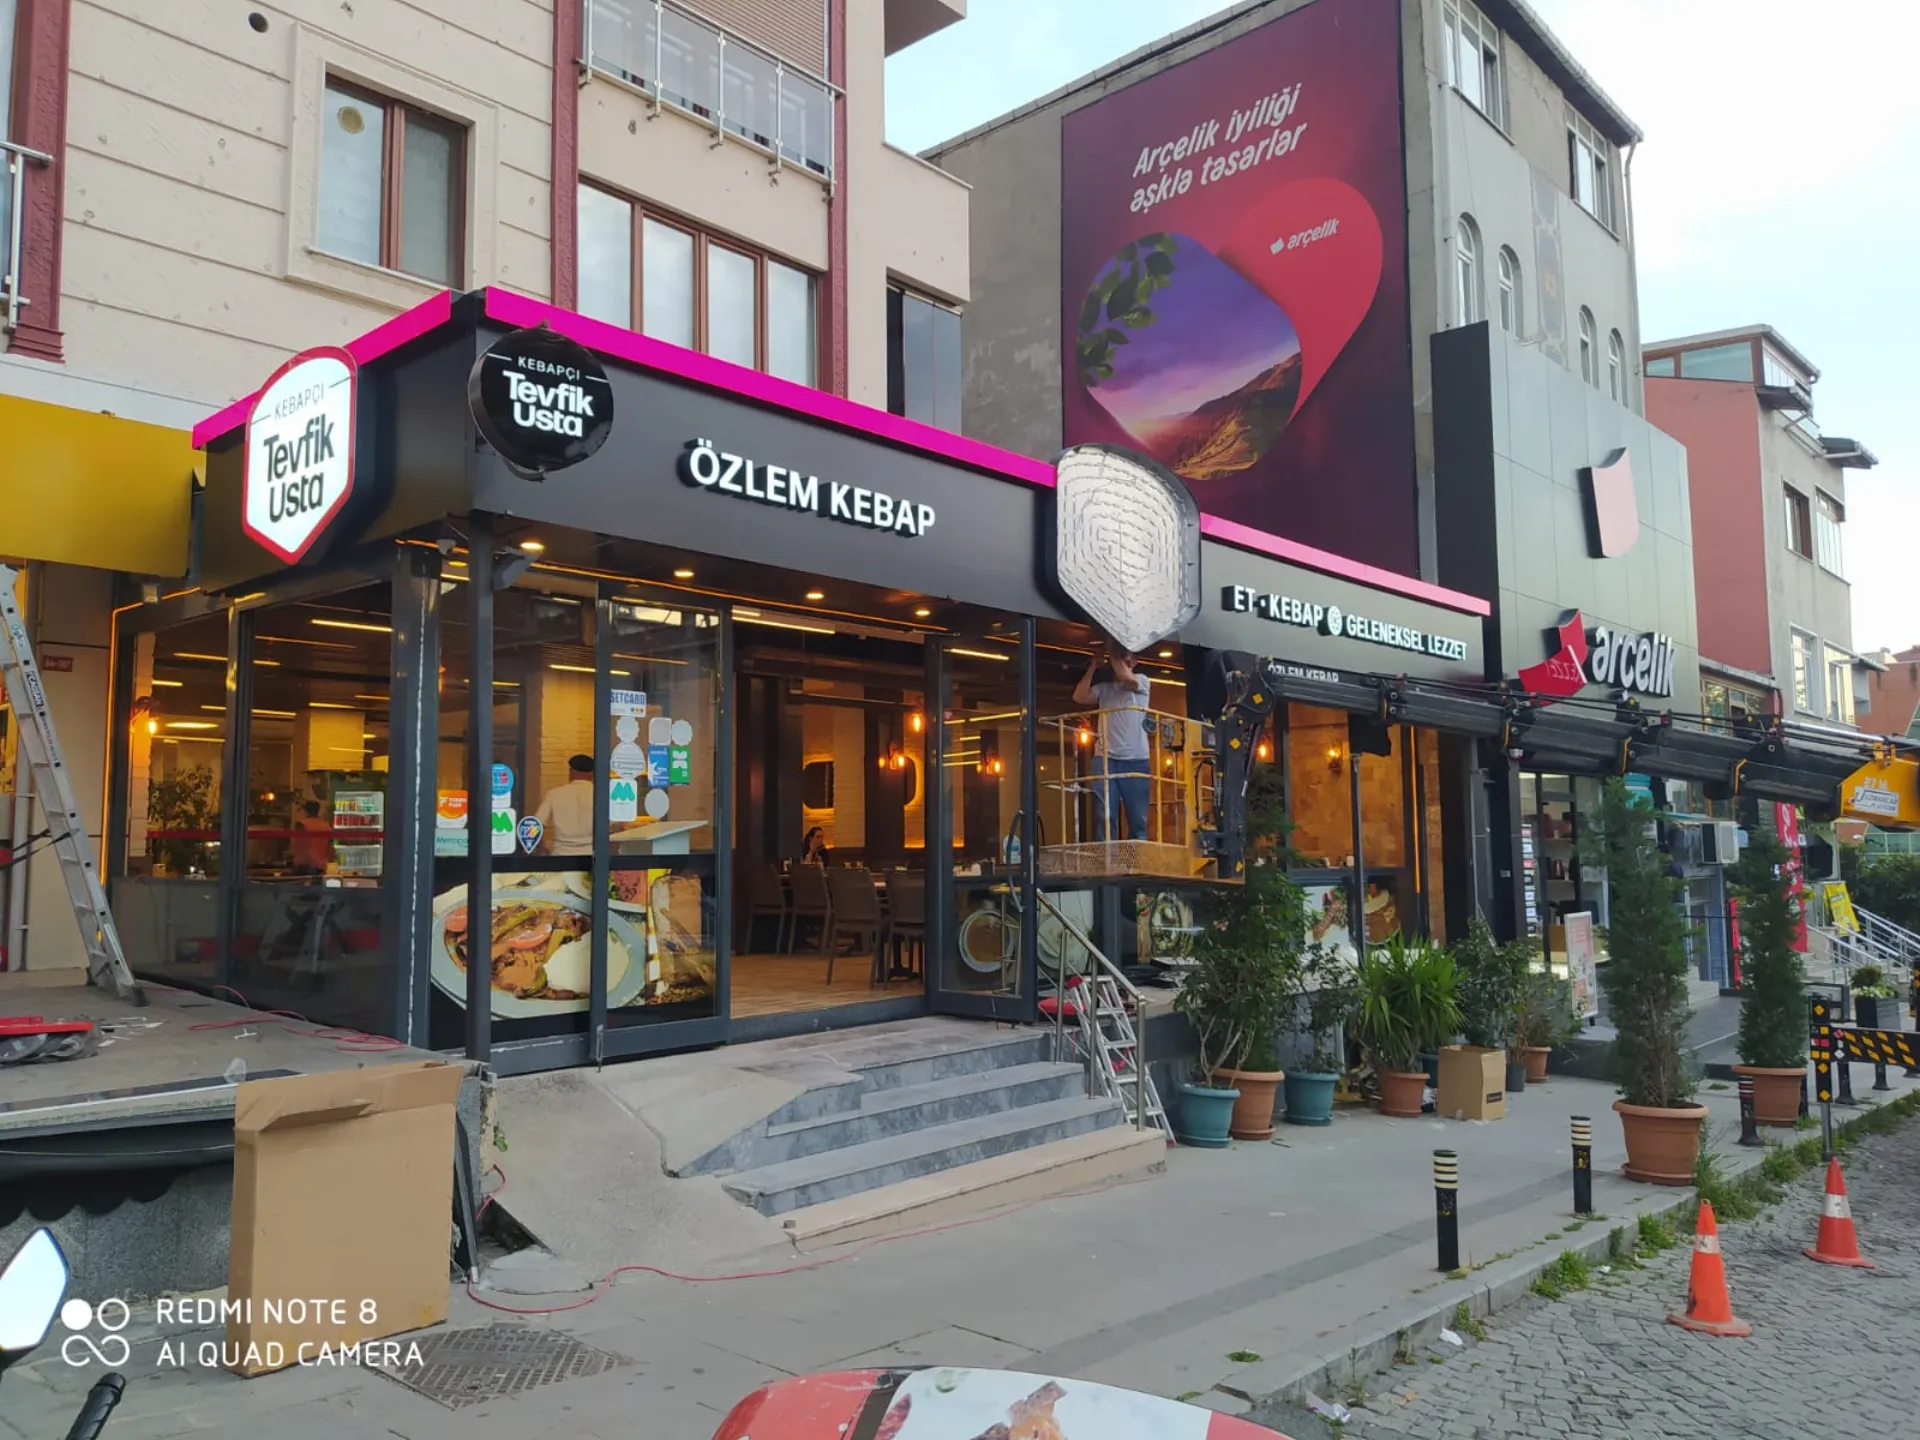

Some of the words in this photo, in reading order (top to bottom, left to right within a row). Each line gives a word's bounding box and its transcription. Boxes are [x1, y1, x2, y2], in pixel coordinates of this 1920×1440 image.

[1132, 118, 1220, 178] Arçelik
[1224, 82, 1302, 143] iyiliği
[1130, 167, 1194, 214] aşkla
[1200, 122, 1308, 186] tasarlar
[1286, 217, 1340, 250] arçelik
[502, 369, 595, 417] Tevfik
[517, 356, 581, 381] KEBAPÇI
[274, 381, 325, 420] KEBAPÇI
[513, 401, 583, 438] Usta
[263, 412, 335, 483] Tevfik
[268, 471, 325, 524] Usta
[689, 437, 819, 511] ÖZLEM
[830, 480, 936, 536] KEBAP
[1233, 584, 1257, 613] ET
[1269, 593, 1324, 630] KEBAP
[1345, 613, 1425, 652] GELENEKSEL
[1427, 634, 1468, 661] LEZZET
[1591, 625, 1676, 701] arçelik
[610, 691, 645, 706] SETCARD
